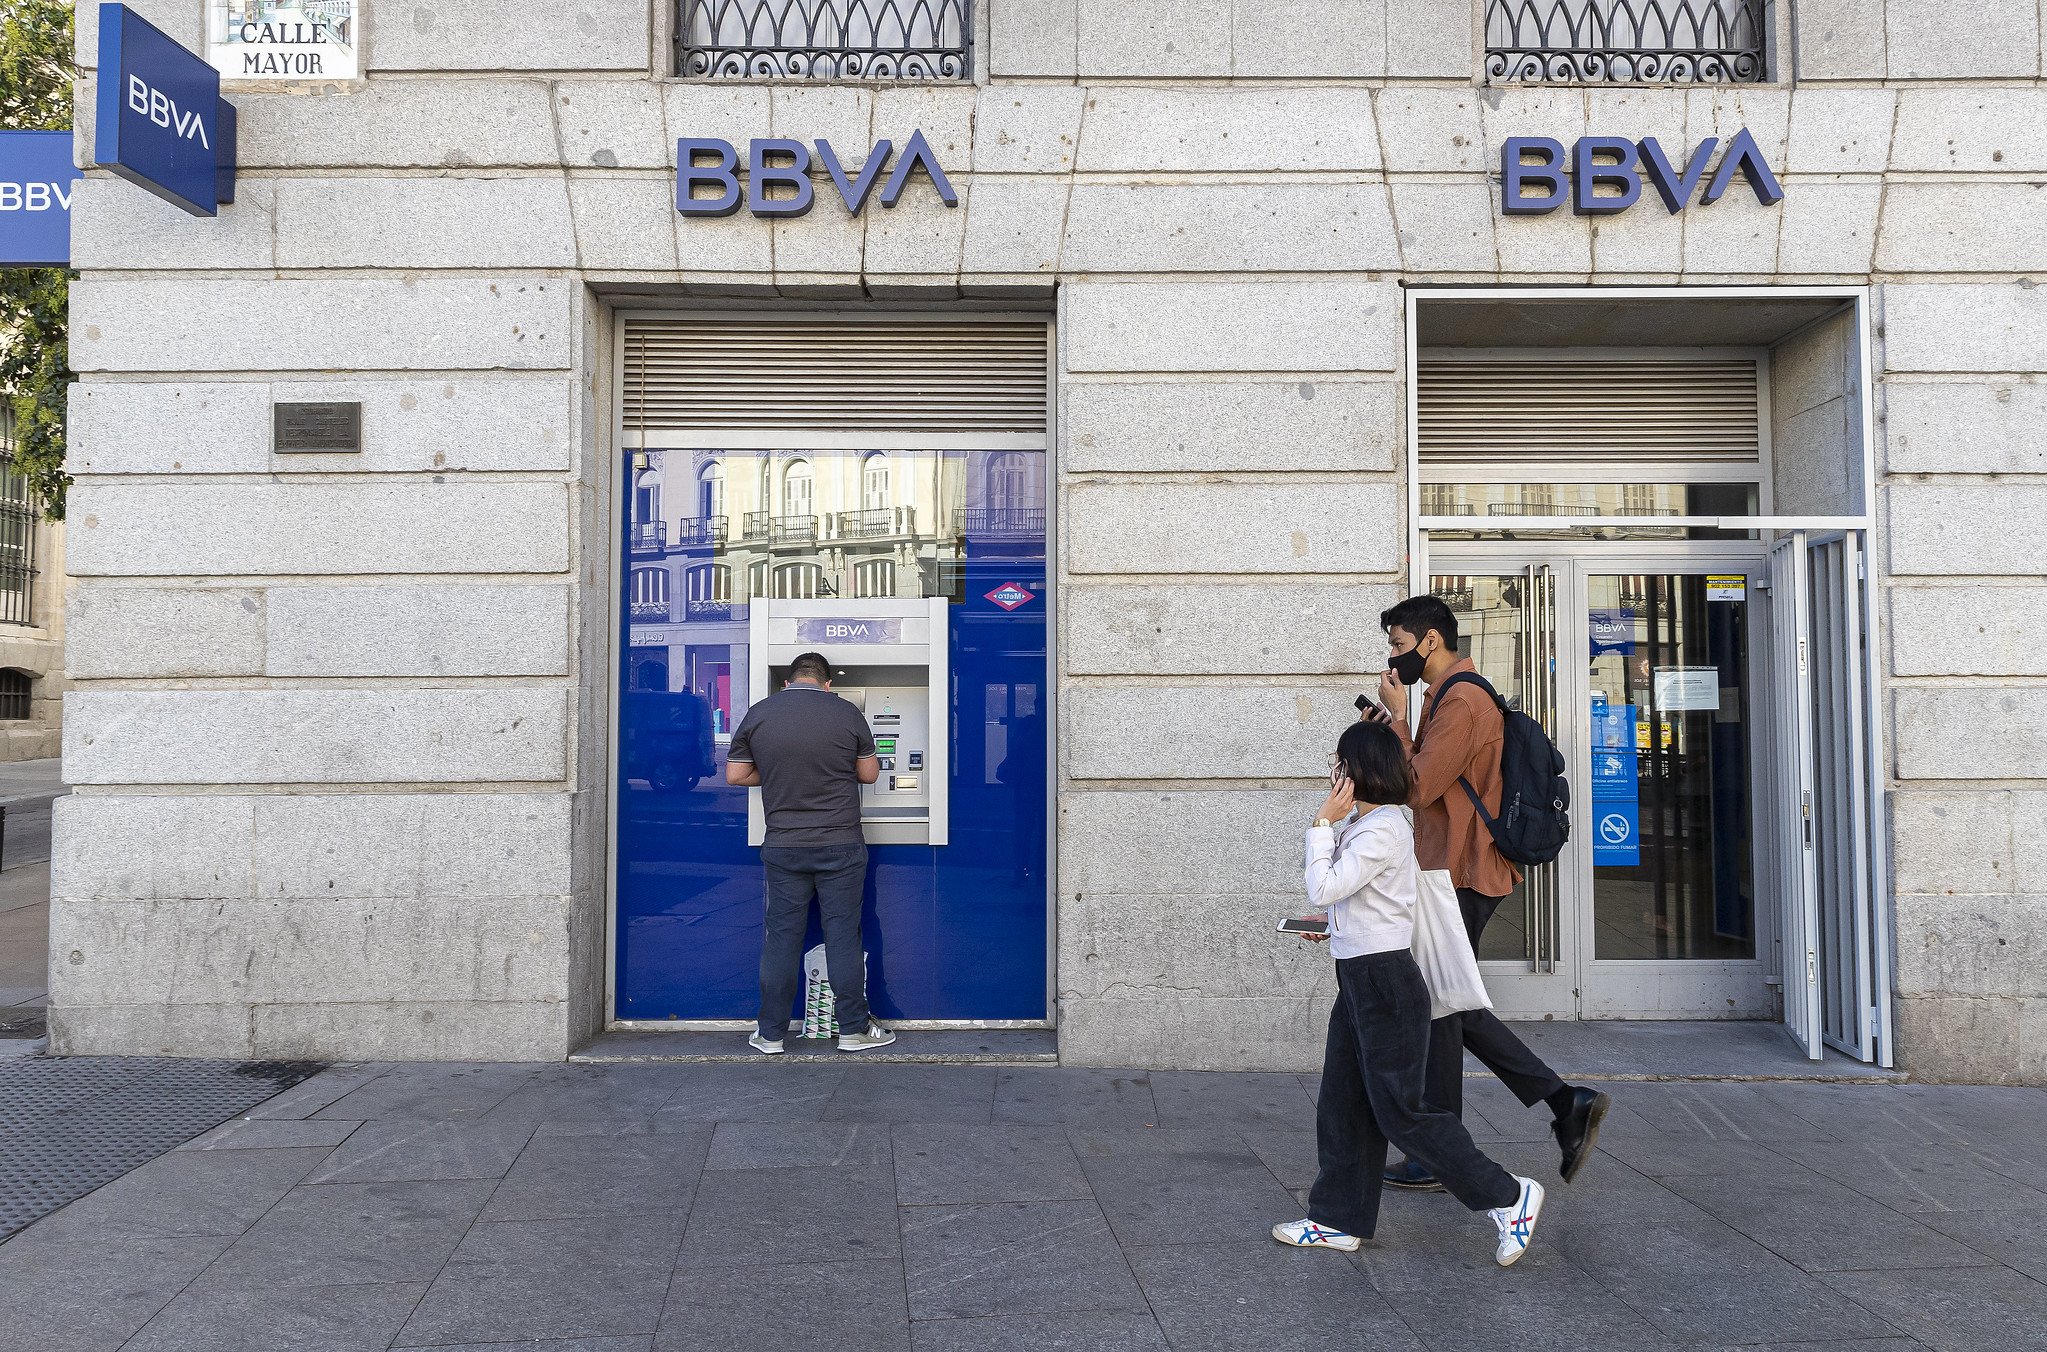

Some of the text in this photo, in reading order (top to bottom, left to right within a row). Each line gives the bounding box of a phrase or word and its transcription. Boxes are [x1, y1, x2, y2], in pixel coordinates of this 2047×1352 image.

[240, 22, 327, 44] CALLE
[243, 52, 323, 74] MAYOR
[129, 73, 210, 150] BBVA
[676, 128, 958, 218] BBVA
[1501, 127, 1785, 216] BBVA
[826, 623, 870, 637] BBVA
[1595, 623, 1627, 633] BBVA
